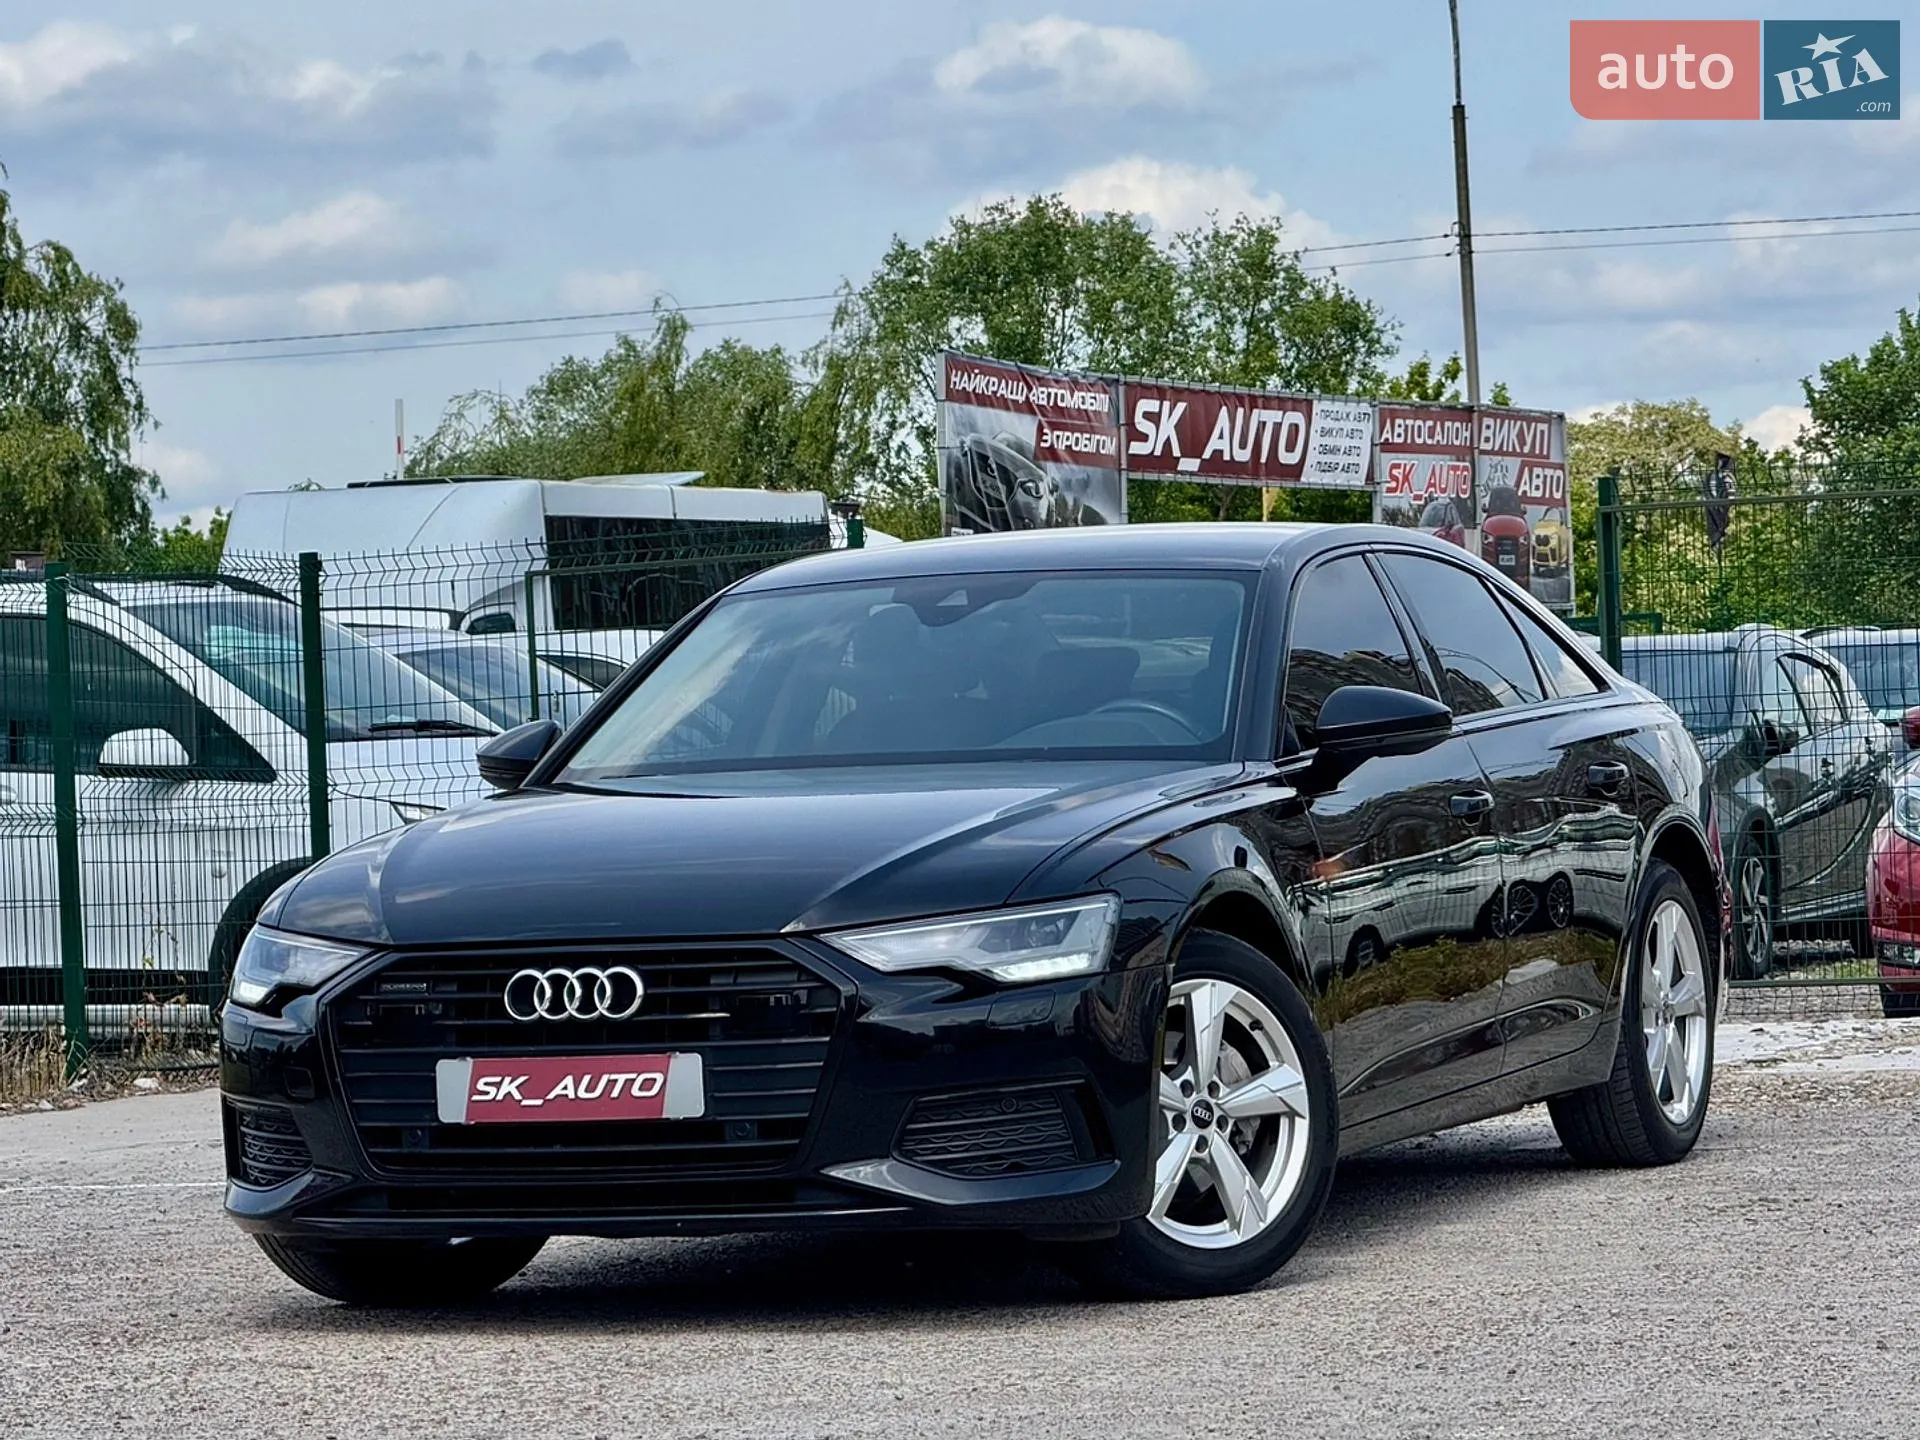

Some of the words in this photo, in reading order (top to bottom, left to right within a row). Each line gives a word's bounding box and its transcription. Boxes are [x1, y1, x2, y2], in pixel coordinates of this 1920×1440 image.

[1029, 386, 1109, 413] АВТОМОБІЛІ
[1320, 409, 1351, 422] ПРОДАЖ
[1052, 430, 1117, 455] ПРОБІГОМ
[1128, 398, 1306, 472] SK_AUTO
[1320, 426, 1344, 438] ВИКУП
[1345, 428, 1363, 440] АВТО
[1380, 418, 1472, 447] АВТОСАЛОН
[1479, 417, 1549, 455] ВИКУП
[1342, 445, 1361, 457] АВТО
[1340, 463, 1361, 474] АВТО
[1383, 461, 1472, 503] SK_AUTO
[1518, 466, 1564, 499] АВТО
[471, 1072, 665, 1106] SK_AUTO
